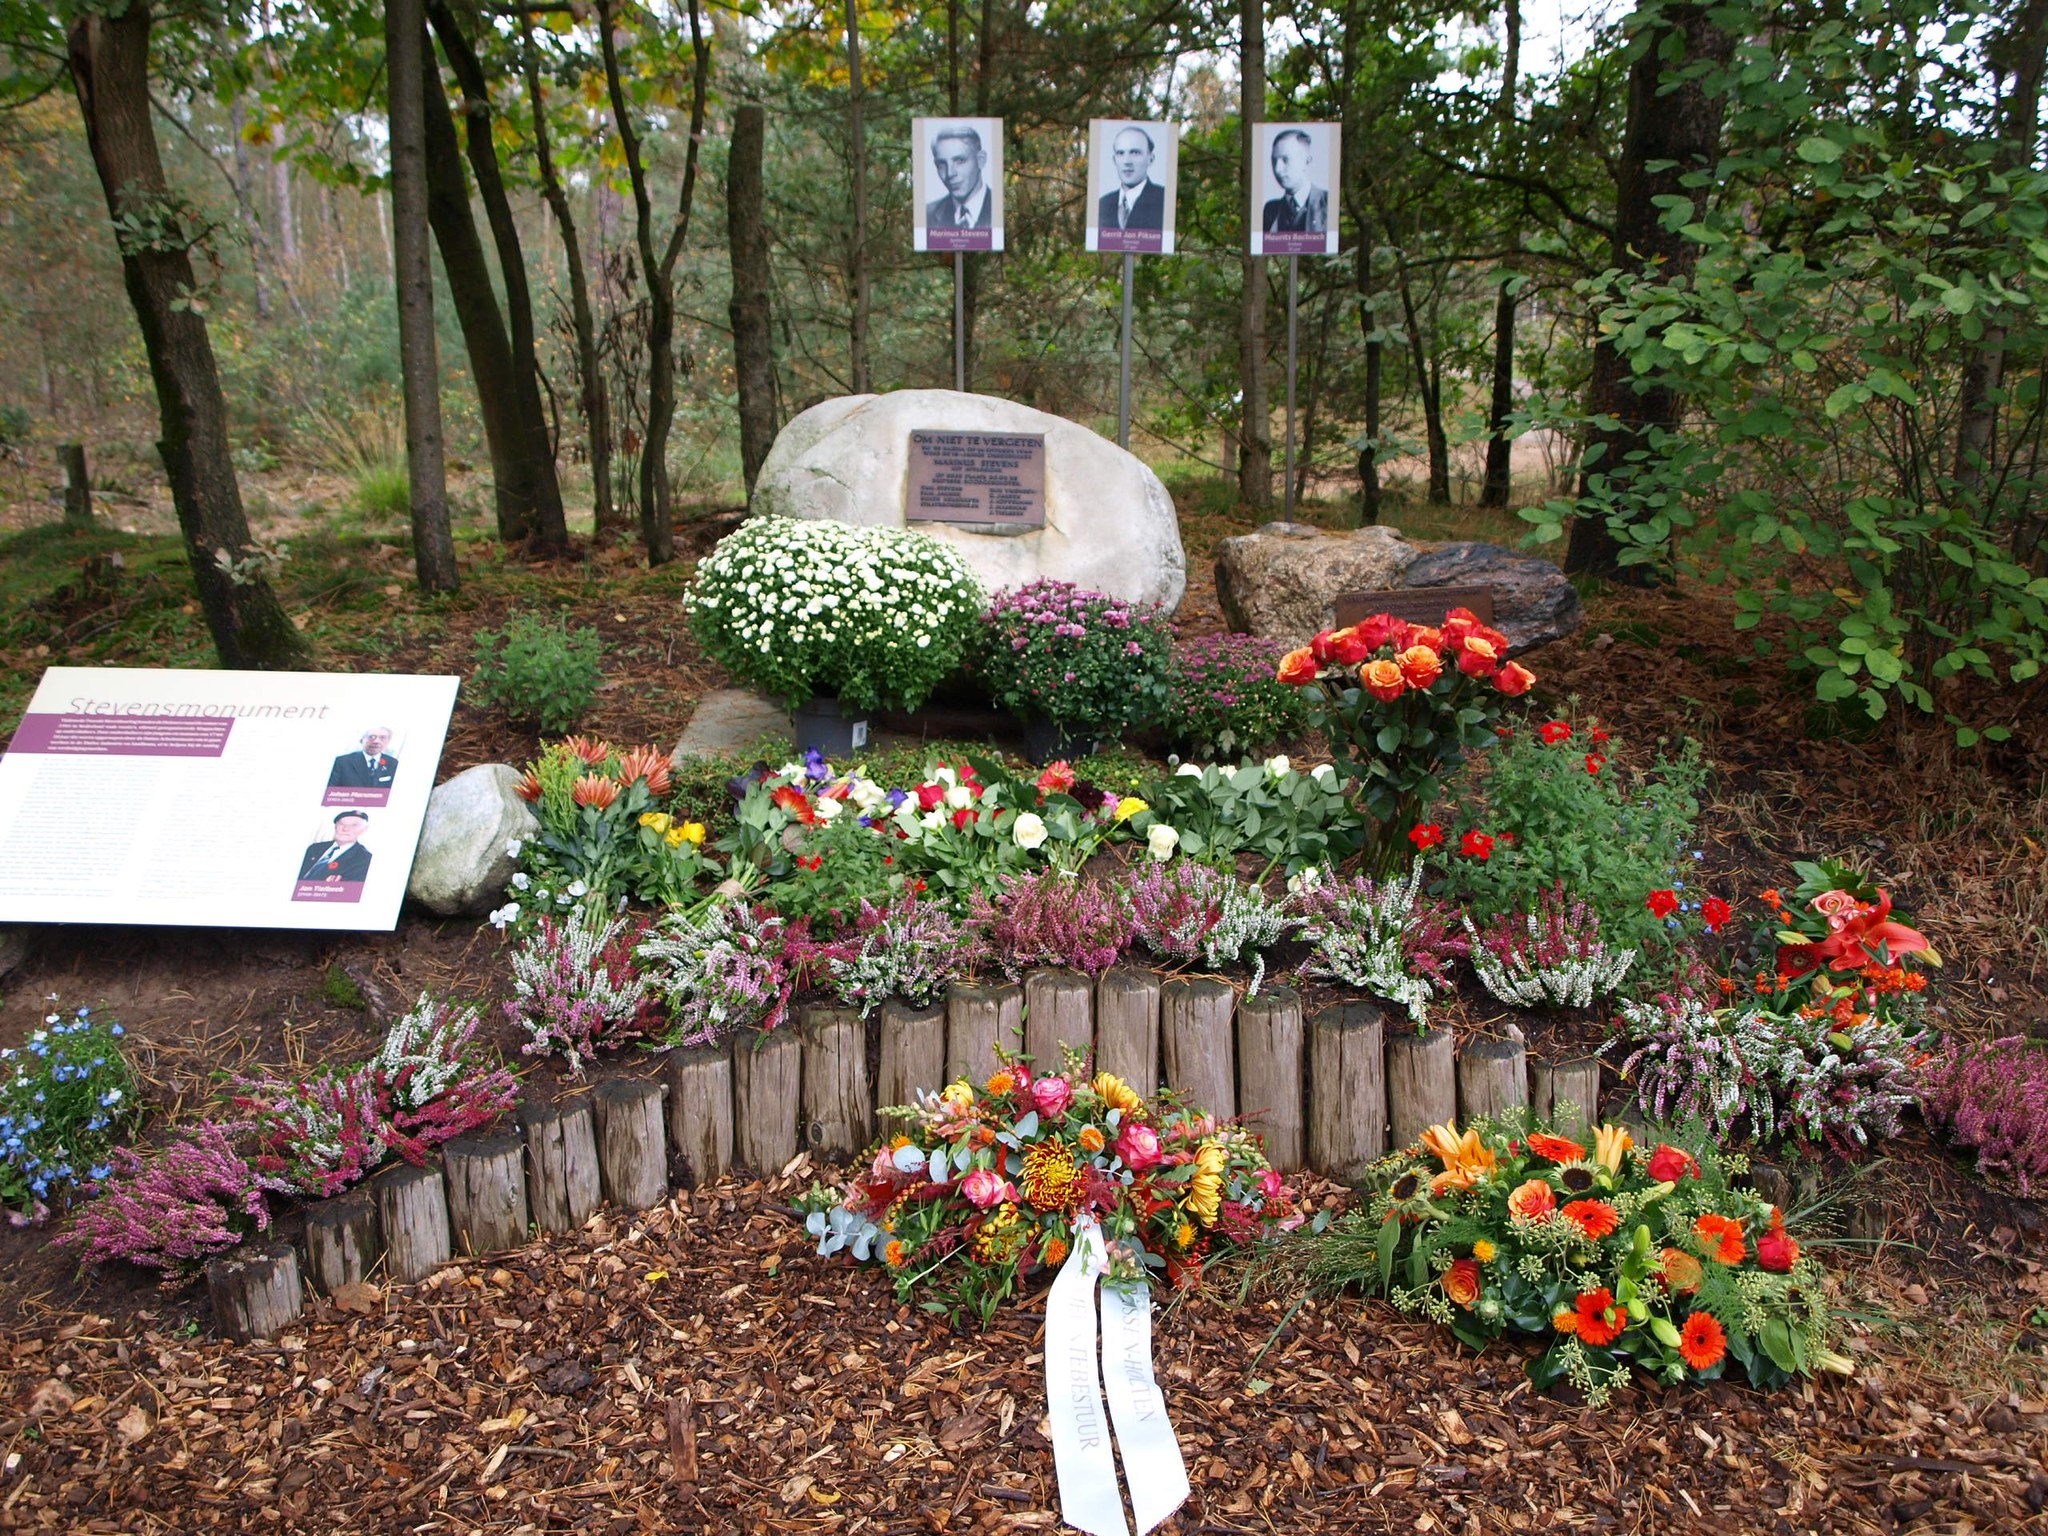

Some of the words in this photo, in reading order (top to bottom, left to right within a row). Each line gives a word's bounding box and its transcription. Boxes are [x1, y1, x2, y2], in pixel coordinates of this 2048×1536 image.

[913, 435, 933, 443] OM
[936, 436, 963, 445] NIET
[965, 437, 980, 445] TE
[982, 438, 1042, 448] VERGETEN
[980, 460, 1019, 468] STEVENS
[69, 697, 330, 720] Stevensmonument
[1122, 1290, 1158, 1422] SSEN-HOLTEN
